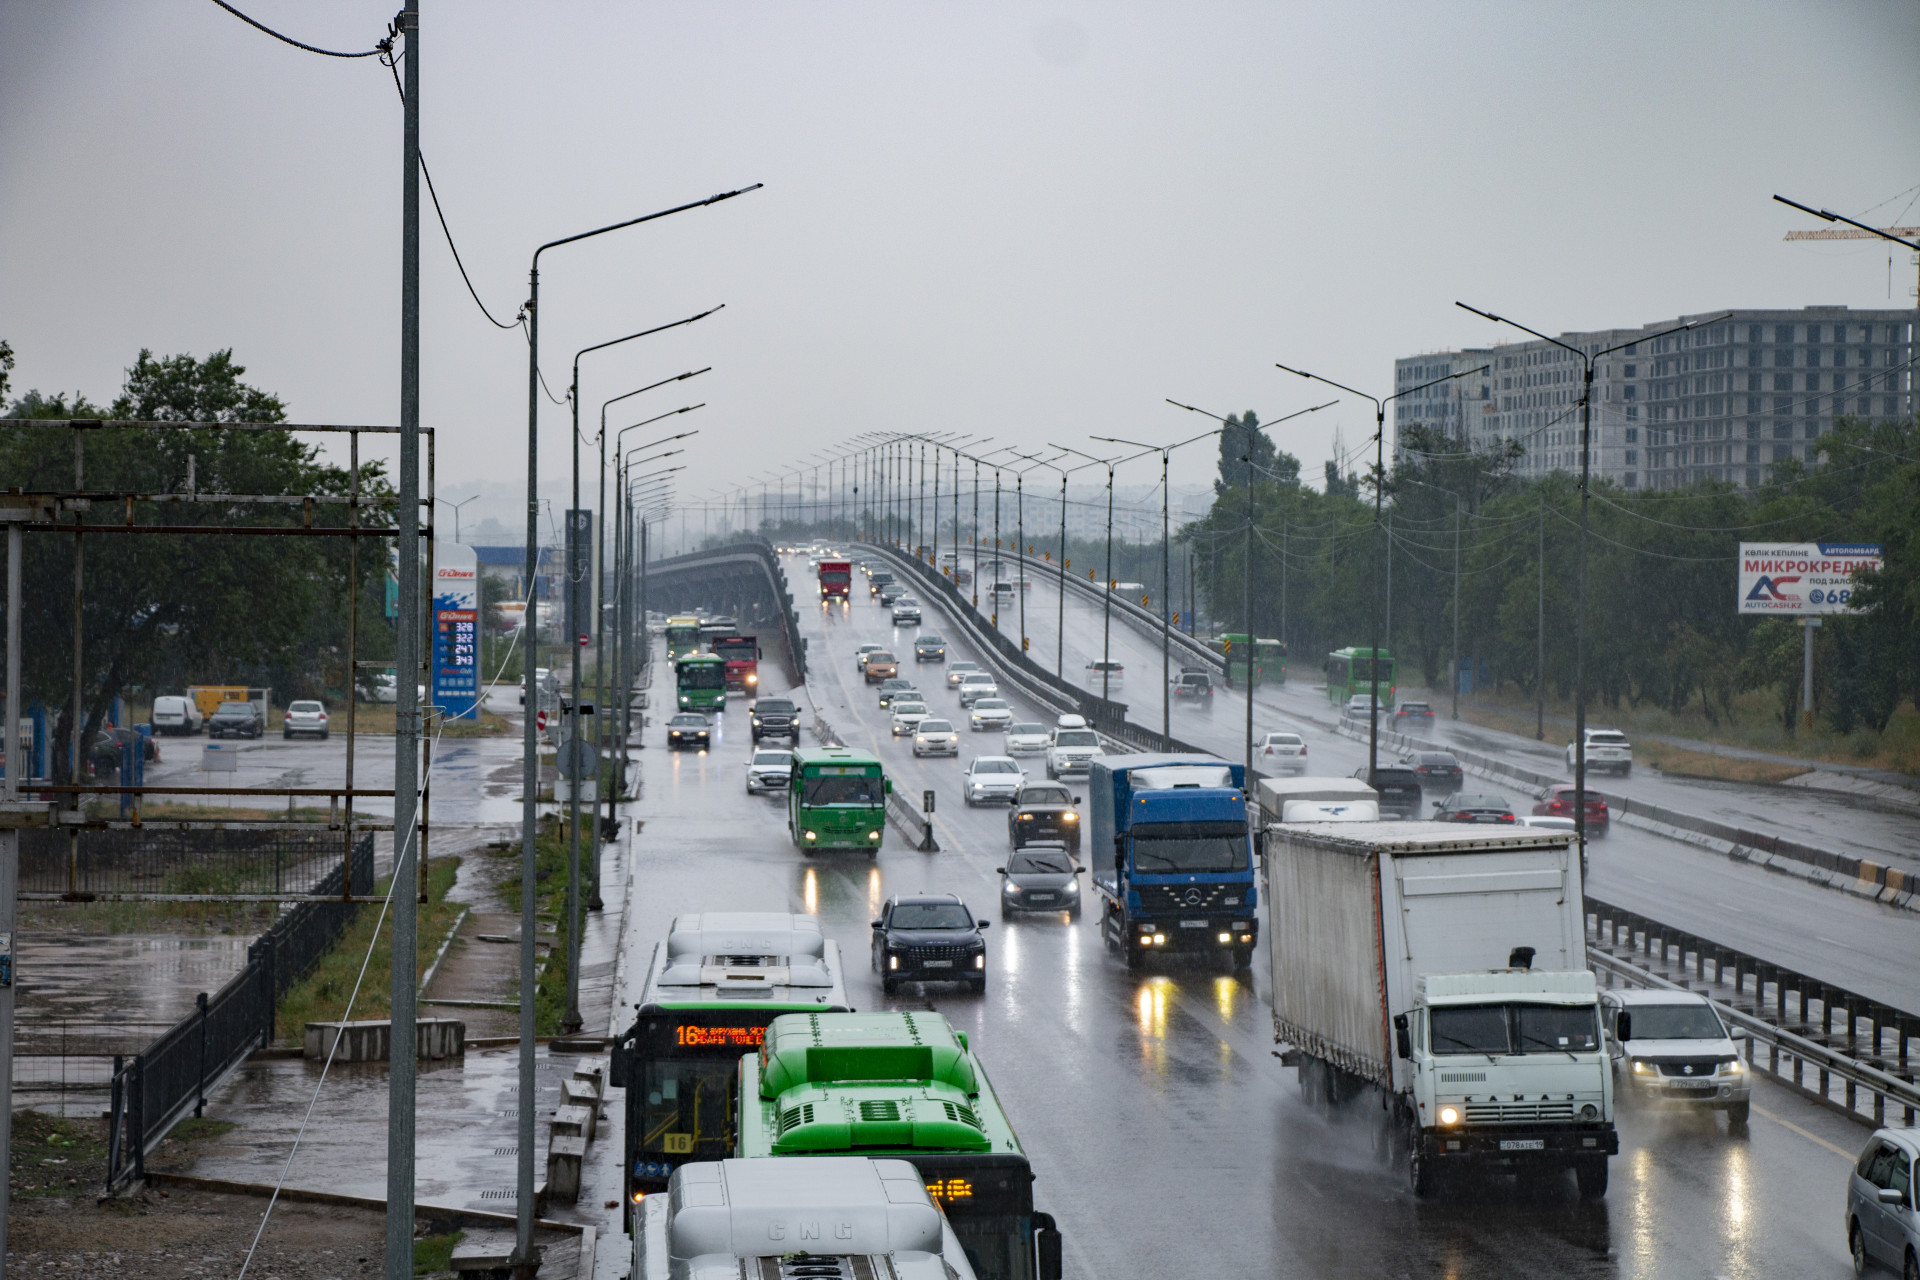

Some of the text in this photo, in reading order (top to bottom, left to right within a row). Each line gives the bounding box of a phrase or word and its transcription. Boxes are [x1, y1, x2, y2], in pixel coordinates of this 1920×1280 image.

[456, 622, 474, 632] 328
[456, 633, 473, 643] 322
[455, 644, 474, 654] 247
[456, 655, 474, 665] 343
[676, 1025, 699, 1045] 16
[669, 1136, 686, 1150] 16
[768, 1222, 853, 1241] CNG
